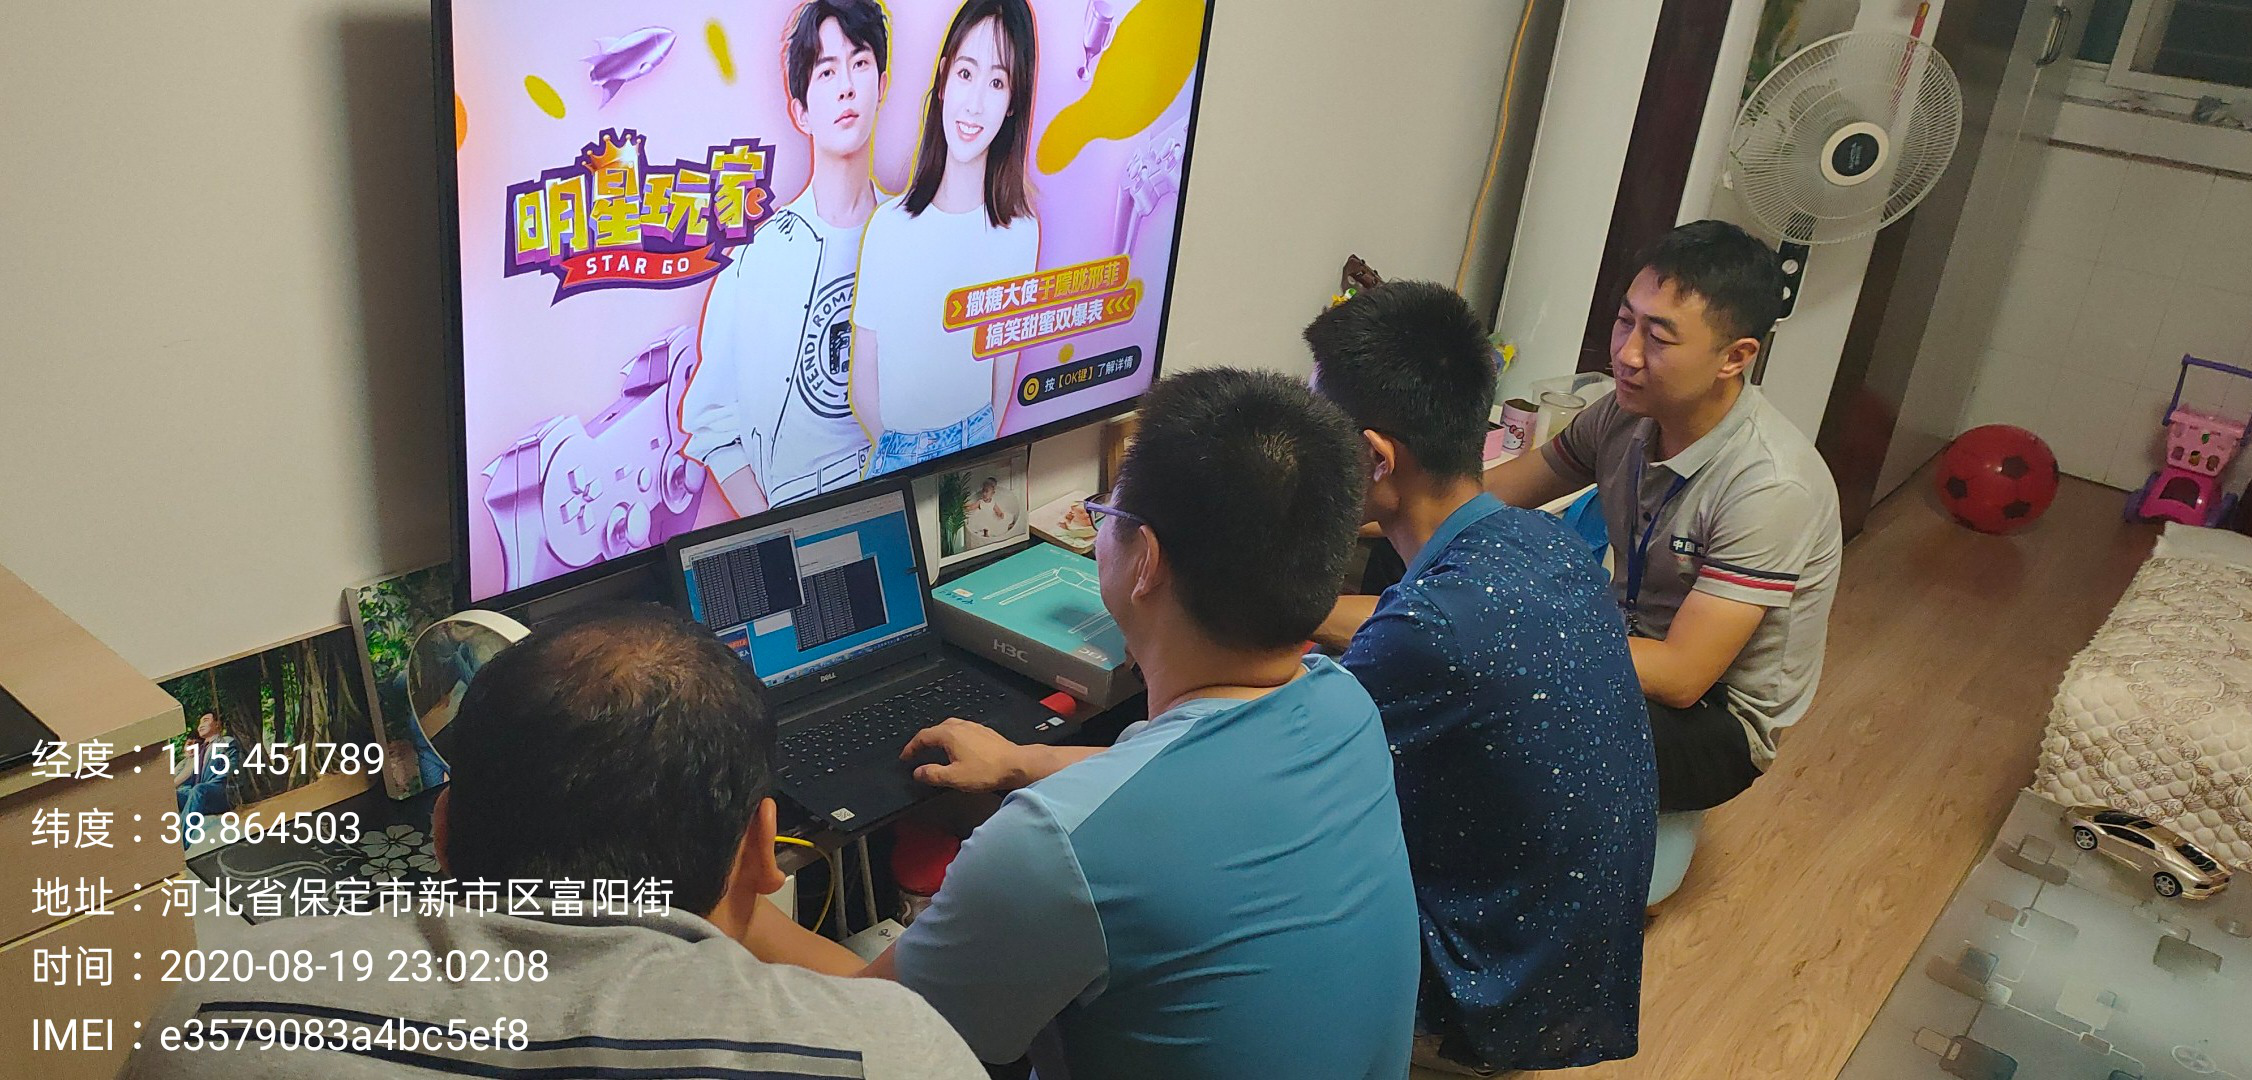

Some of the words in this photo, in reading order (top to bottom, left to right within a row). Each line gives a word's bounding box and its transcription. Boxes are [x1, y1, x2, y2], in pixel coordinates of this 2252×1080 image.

[515, 146, 765, 259] 明星玩家
[586, 255, 647, 275] STAR
[661, 256, 690, 275] GO
[985, 299, 1104, 350] 搞笑甜蜜双爆表
[993, 639, 1028, 663] H3C
